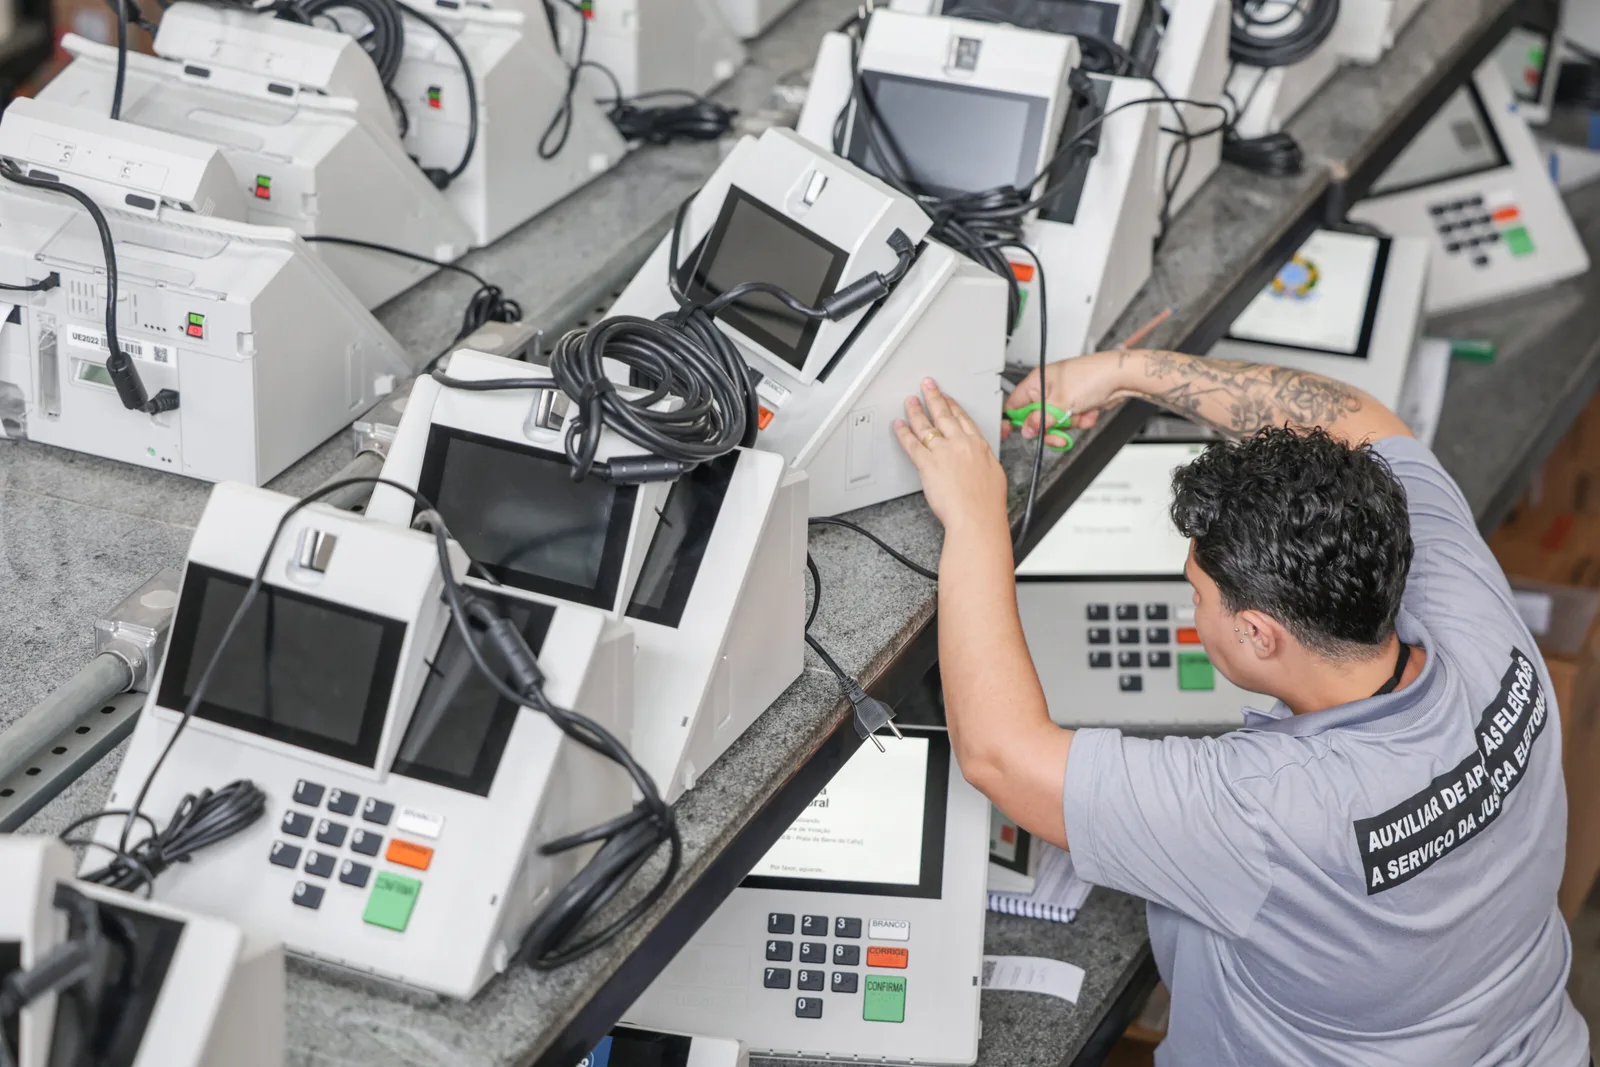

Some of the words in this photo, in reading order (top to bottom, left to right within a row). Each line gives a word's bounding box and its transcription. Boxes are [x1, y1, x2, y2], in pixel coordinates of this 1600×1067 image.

[72, 332, 100, 345] UE2022
[297, 780, 306, 794] 1
[330, 788, 342, 804] 2
[365, 797, 376, 813] 3
[1369, 796, 1443, 853] AUXILIAR
[1440, 780, 1467, 811] DE
[1465, 763, 1486, 796] AP
[1481, 725, 1504, 757] ÀS
[284, 810, 294, 825] 4
[1371, 867, 1384, 887] A
[1388, 829, 1454, 880] SERVIÇO
[1458, 813, 1477, 839] DA
[1478, 760, 1518, 823] JUSIÇA
[273, 841, 284, 855] 7
[771, 914, 777, 925] 1
[803, 916, 812, 927] 2
[837, 918, 846, 929] 3
[872, 920, 907, 929] BRANCO
[768, 941, 776, 952] 4
[802, 943, 810, 954] 5
[835, 945, 844, 956] 6
[869, 947, 906, 957] CORRIGE
[767, 969, 774, 980] 7
[799, 971, 808, 982] 8
[834, 973, 842, 984] 9
[867, 981, 905, 993] CONFIRMA
[798, 998, 806, 1010] 0
